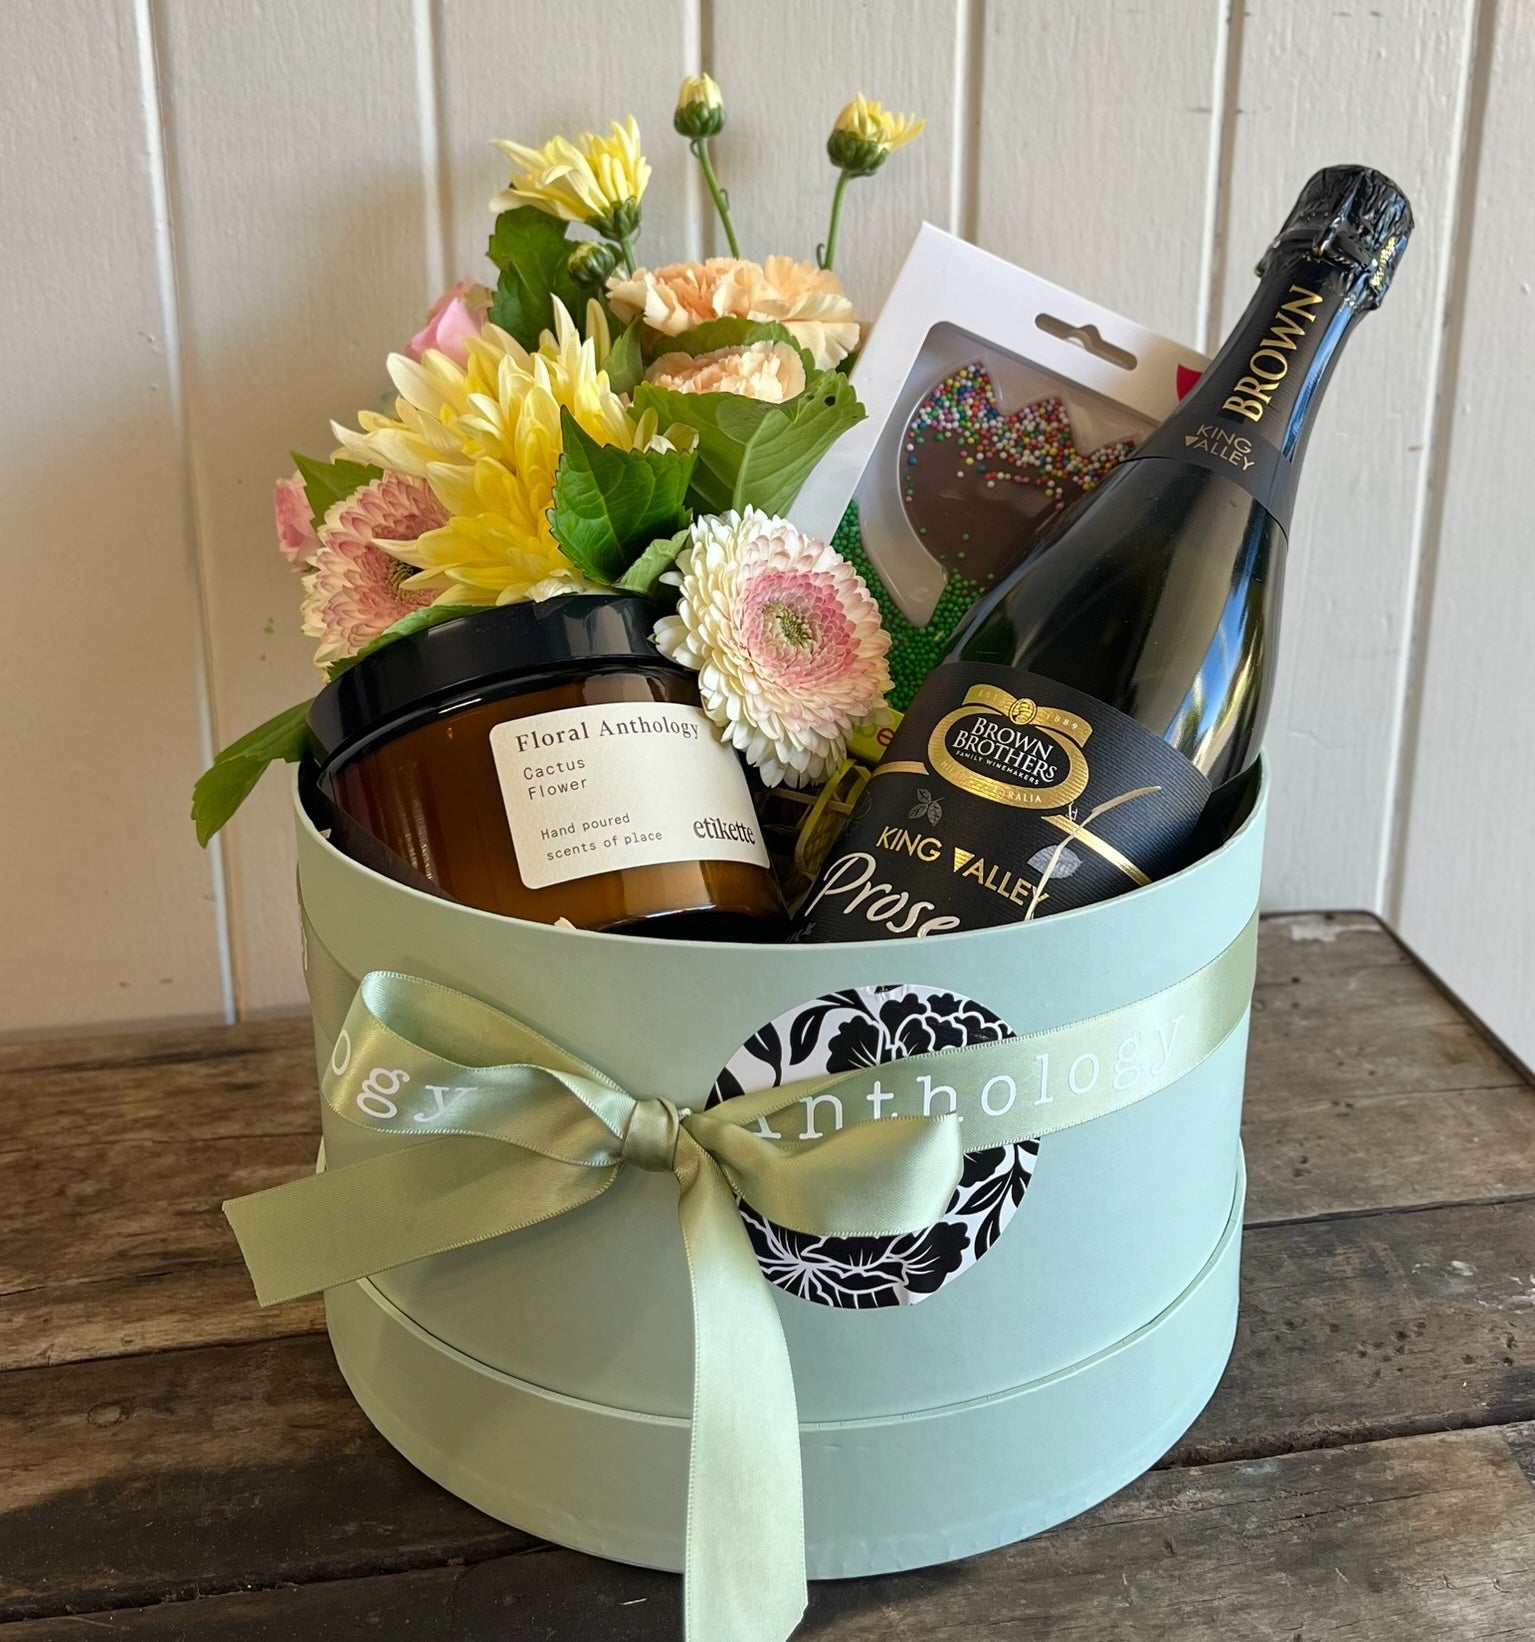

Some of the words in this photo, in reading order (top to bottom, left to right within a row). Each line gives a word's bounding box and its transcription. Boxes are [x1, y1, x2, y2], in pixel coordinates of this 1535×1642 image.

[1222, 284, 1323, 422] BROWN
[1196, 424, 1252, 454] KING
[515, 722, 590, 752] Floral
[599, 716, 699, 739] Anthology
[971, 717, 1054, 760] BROWN
[523, 758, 586, 780] Cactus
[952, 730, 1058, 782] BROTHERS
[956, 750, 984, 762] FAMILY
[986, 758, 1039, 785] WINEMAKERS
[528, 777, 588, 800] Flower
[540, 823, 576, 841] Hand
[582, 812, 631, 832] poured
[876, 826, 942, 862] KING
[547, 842, 597, 861] scents
[603, 835, 618, 849] of
[624, 831, 663, 846] place
